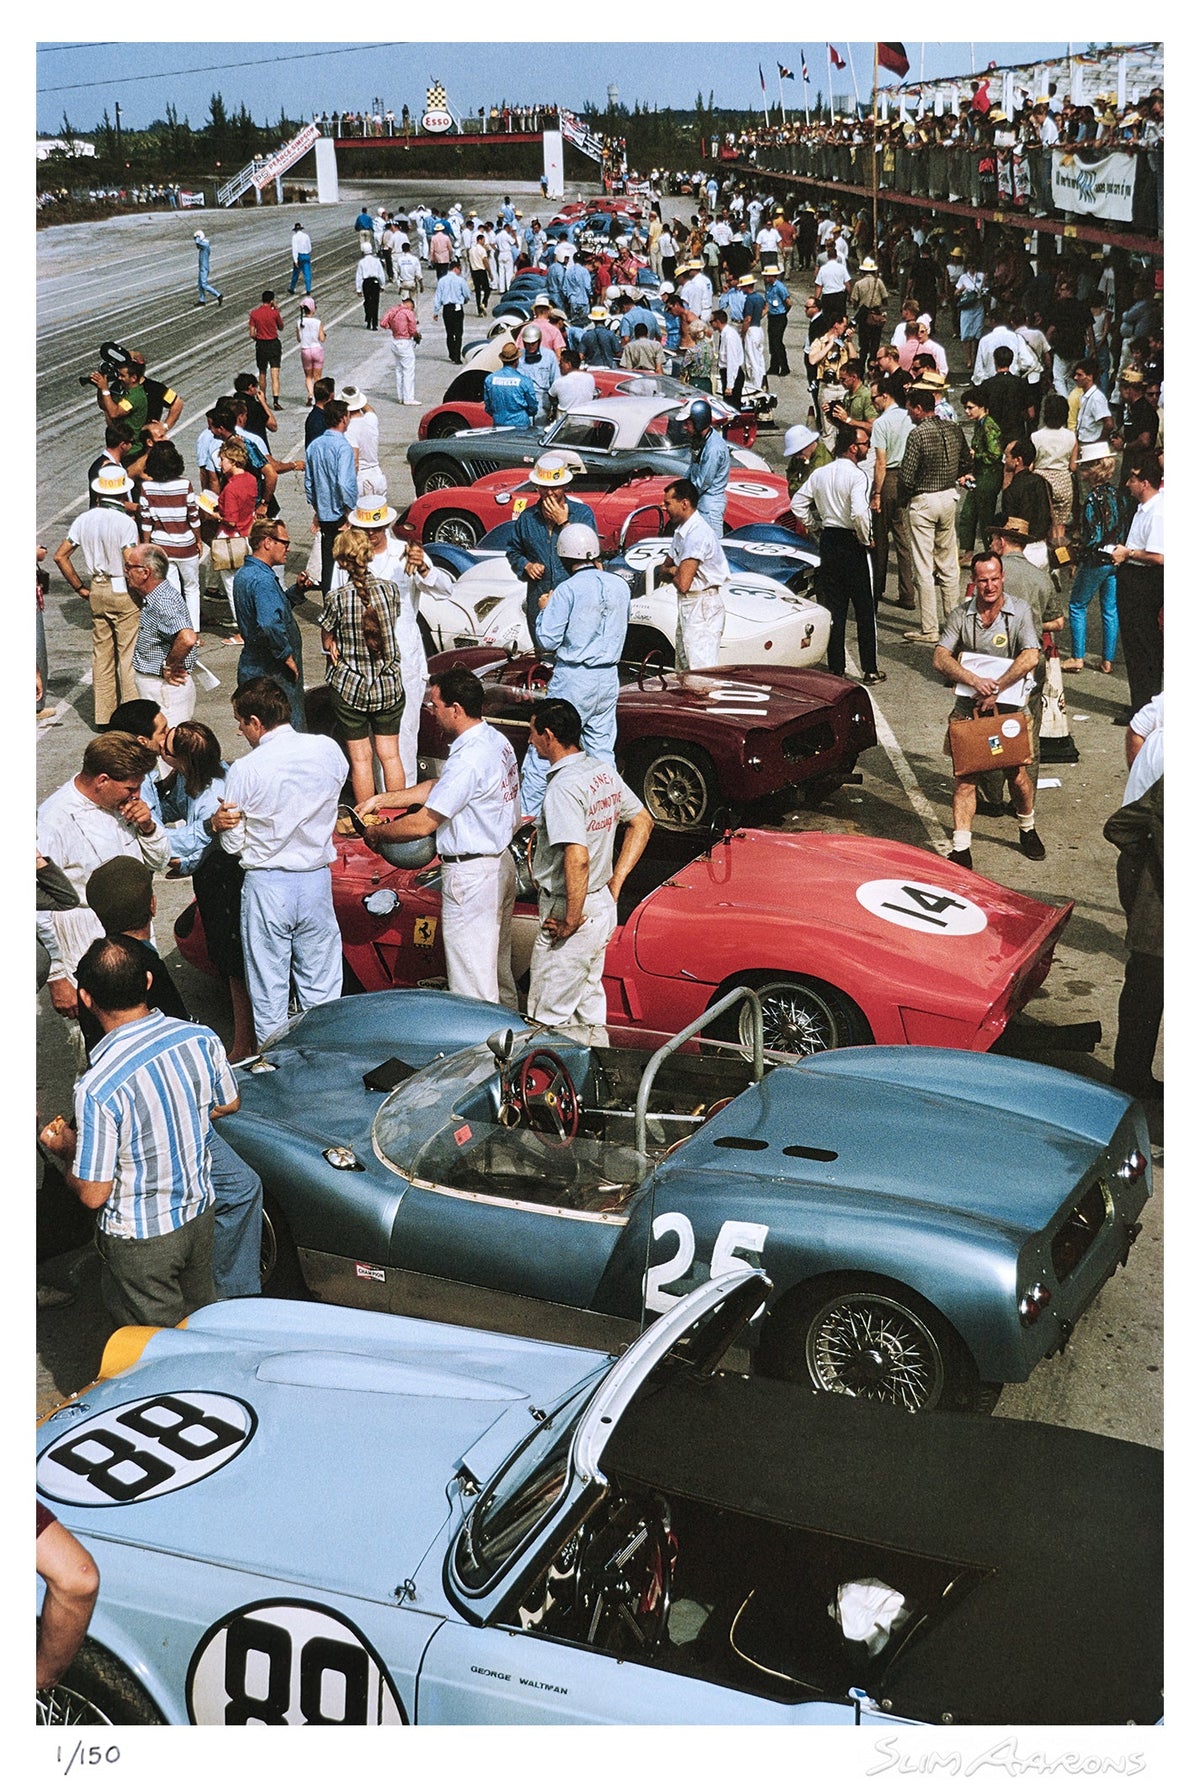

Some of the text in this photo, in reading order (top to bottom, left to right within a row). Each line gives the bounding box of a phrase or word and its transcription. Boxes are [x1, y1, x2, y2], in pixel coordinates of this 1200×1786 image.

[730, 483, 769, 496] 10
[881, 885, 967, 928] 14
[358, 1267, 384, 1278] CHAMPION
[642, 1211, 769, 1322] 25
[48, 1395, 246, 1501] 88
[470, 1665, 568, 1695] GEORGE WALTMAN
[57, 1739, 121, 1776] 1/150
